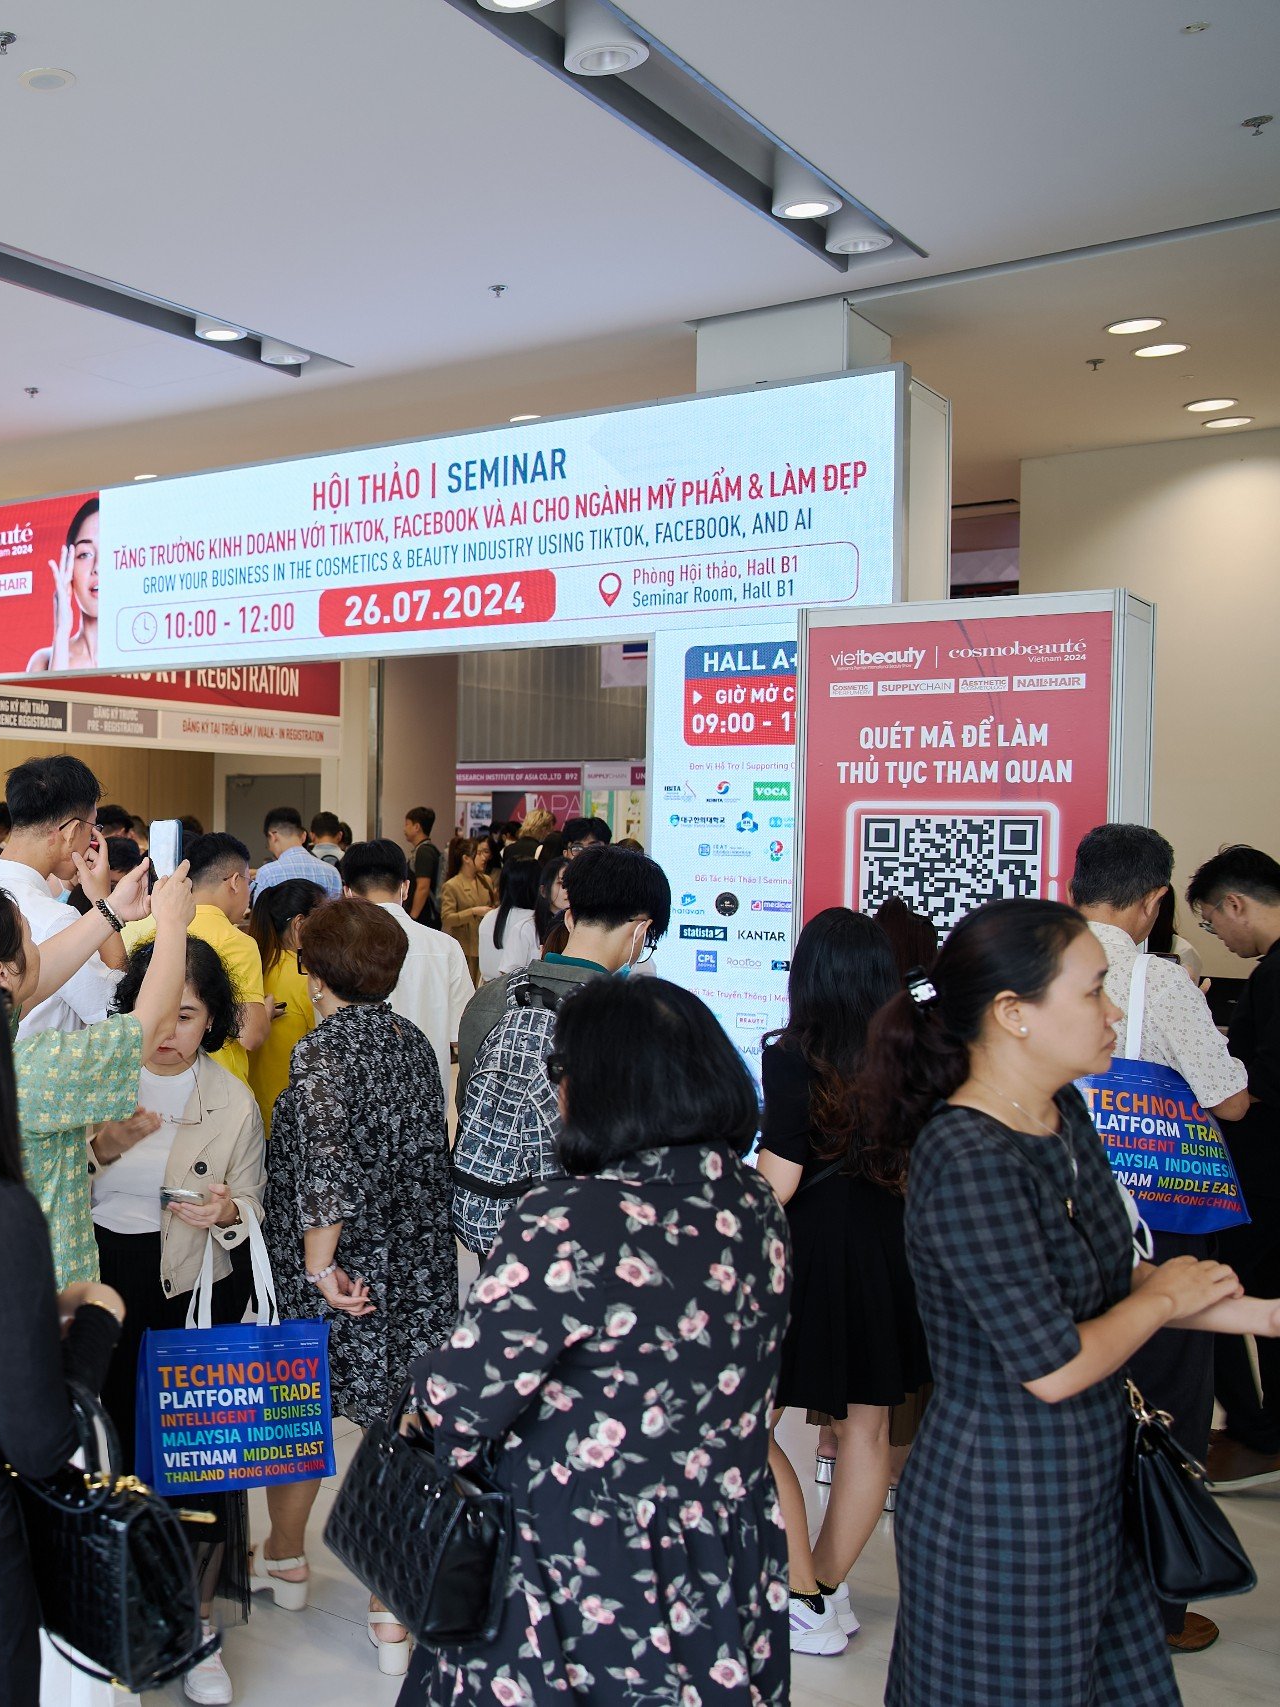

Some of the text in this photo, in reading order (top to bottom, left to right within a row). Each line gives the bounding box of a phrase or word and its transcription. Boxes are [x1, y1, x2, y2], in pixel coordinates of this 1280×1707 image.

[313, 447, 567, 515] HỘI THẢO SEMINAR
[113, 460, 868, 571] TĂNG TRƯỞNG KINH DOANH VỚI TIKTOK, FACEBOOK VÀ AI CHO NGÀNH MỸ PHẨM & LÀM ĐẸP
[12, 544, 33, 556] 2024
[143, 507, 813, 594] GROW YOUR BUSINESS IN THE COSMETICS & BEAUTY INDUSTRY USING TIKTOK, FACEBOOK, AND AI
[633, 554, 799, 588] Phòng Hội thảo, Hall B1
[344, 580, 526, 627] 26.07.2024
[632, 578, 795, 608] Seminar Room, Hall B1
[164, 602, 295, 640] 10:00 12:00
[704, 650, 766, 672] HALL
[830, 639, 1086, 670] vietbeauty cosmobeauté
[1029, 653, 1086, 663] Vietnam 2024
[197, 666, 299, 697] REGISTRATION
[882, 682, 951, 692] SUPPLYCHAIN
[961, 679, 1006, 687] AESTHETIC
[1017, 677, 1081, 688] NAIL&HAIR
[716, 683, 779, 705] GIỜ MỞ
[19, 715, 62, 729] REGISTRATION
[692, 712, 755, 734] 09:00
[859, 715, 1048, 750] QUÉT MÃ ĐỂ LÀM
[258, 727, 274, 739] WALK
[286, 729, 324, 742] REGISTRATION
[485, 773, 514, 781] INSTITUTE
[524, 773, 538, 781] ASIA
[746, 761, 789, 771] Supporting
[836, 754, 1072, 788] THỦ TỤC THAM QUAN
[683, 927, 714, 938] statista
[738, 930, 786, 942] KANTAR
[698, 954, 716, 963] CPL
[1157, 1176, 1210, 1193] MIDDLE
[1212, 1182, 1237, 1197] EAS
[1138, 1191, 1171, 1203] HONG
[1174, 1194, 1204, 1206] KONG
[157, 1357, 319, 1388] TECHNOLOGY
[159, 1382, 321, 1410] PLATFORM TRADE
[161, 1403, 322, 1427] INTELLIGENT BUSINESS
[162, 1420, 323, 1447] MALAYSIA INDONESIA
[163, 1441, 324, 1468] VIETNAM MIDDLE EAST
[165, 1459, 325, 1484] THAILAND HONG KONG CHINA
